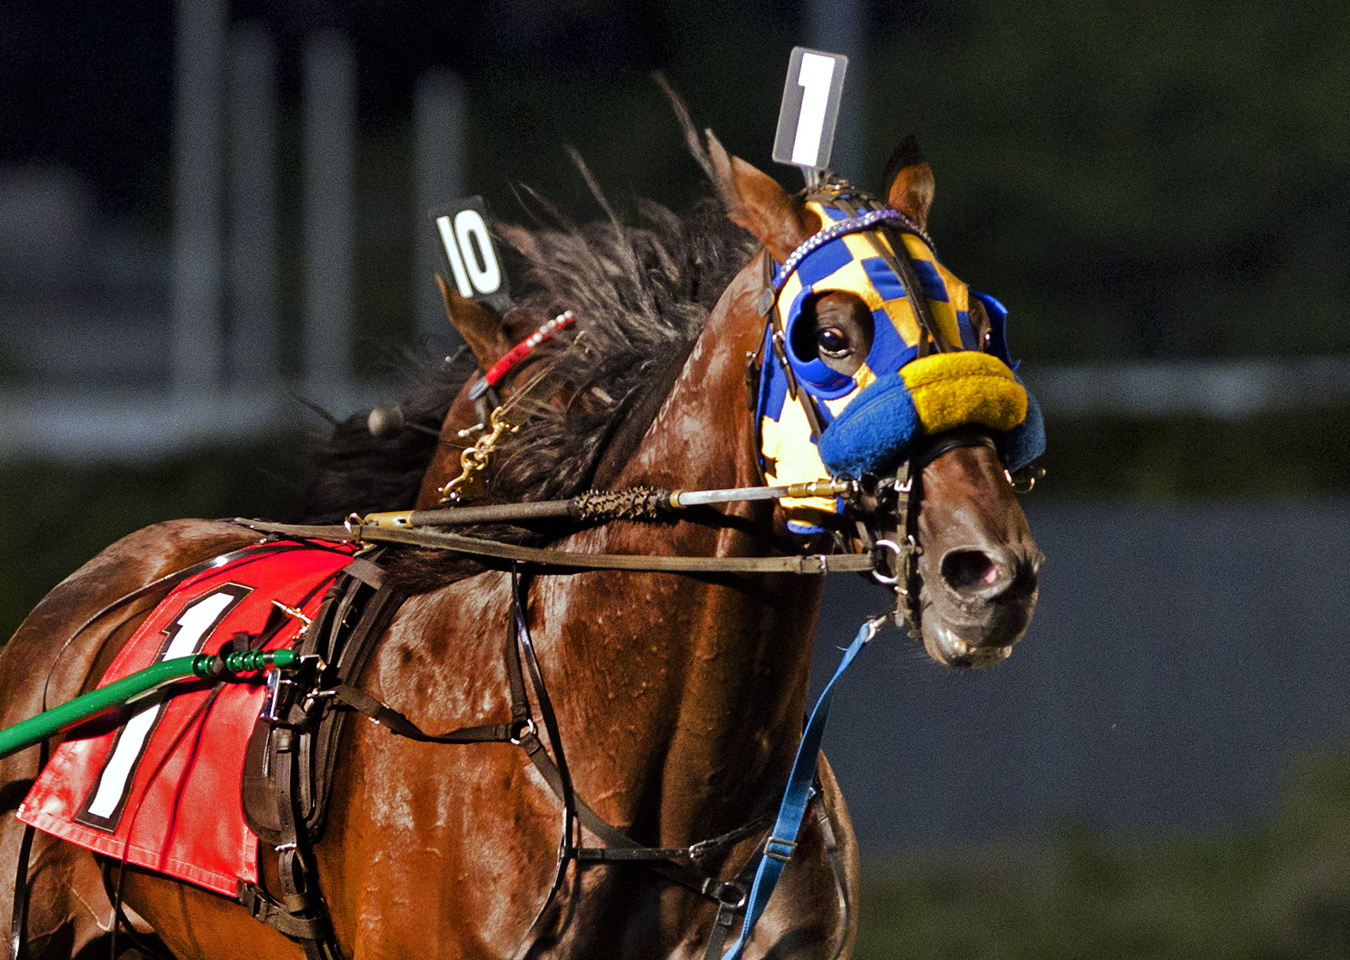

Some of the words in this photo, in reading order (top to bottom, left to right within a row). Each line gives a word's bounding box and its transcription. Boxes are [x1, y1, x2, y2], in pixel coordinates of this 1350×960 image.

[791, 52, 835, 167] 1
[435, 209, 501, 298] 10
[80, 587, 246, 826] 1
